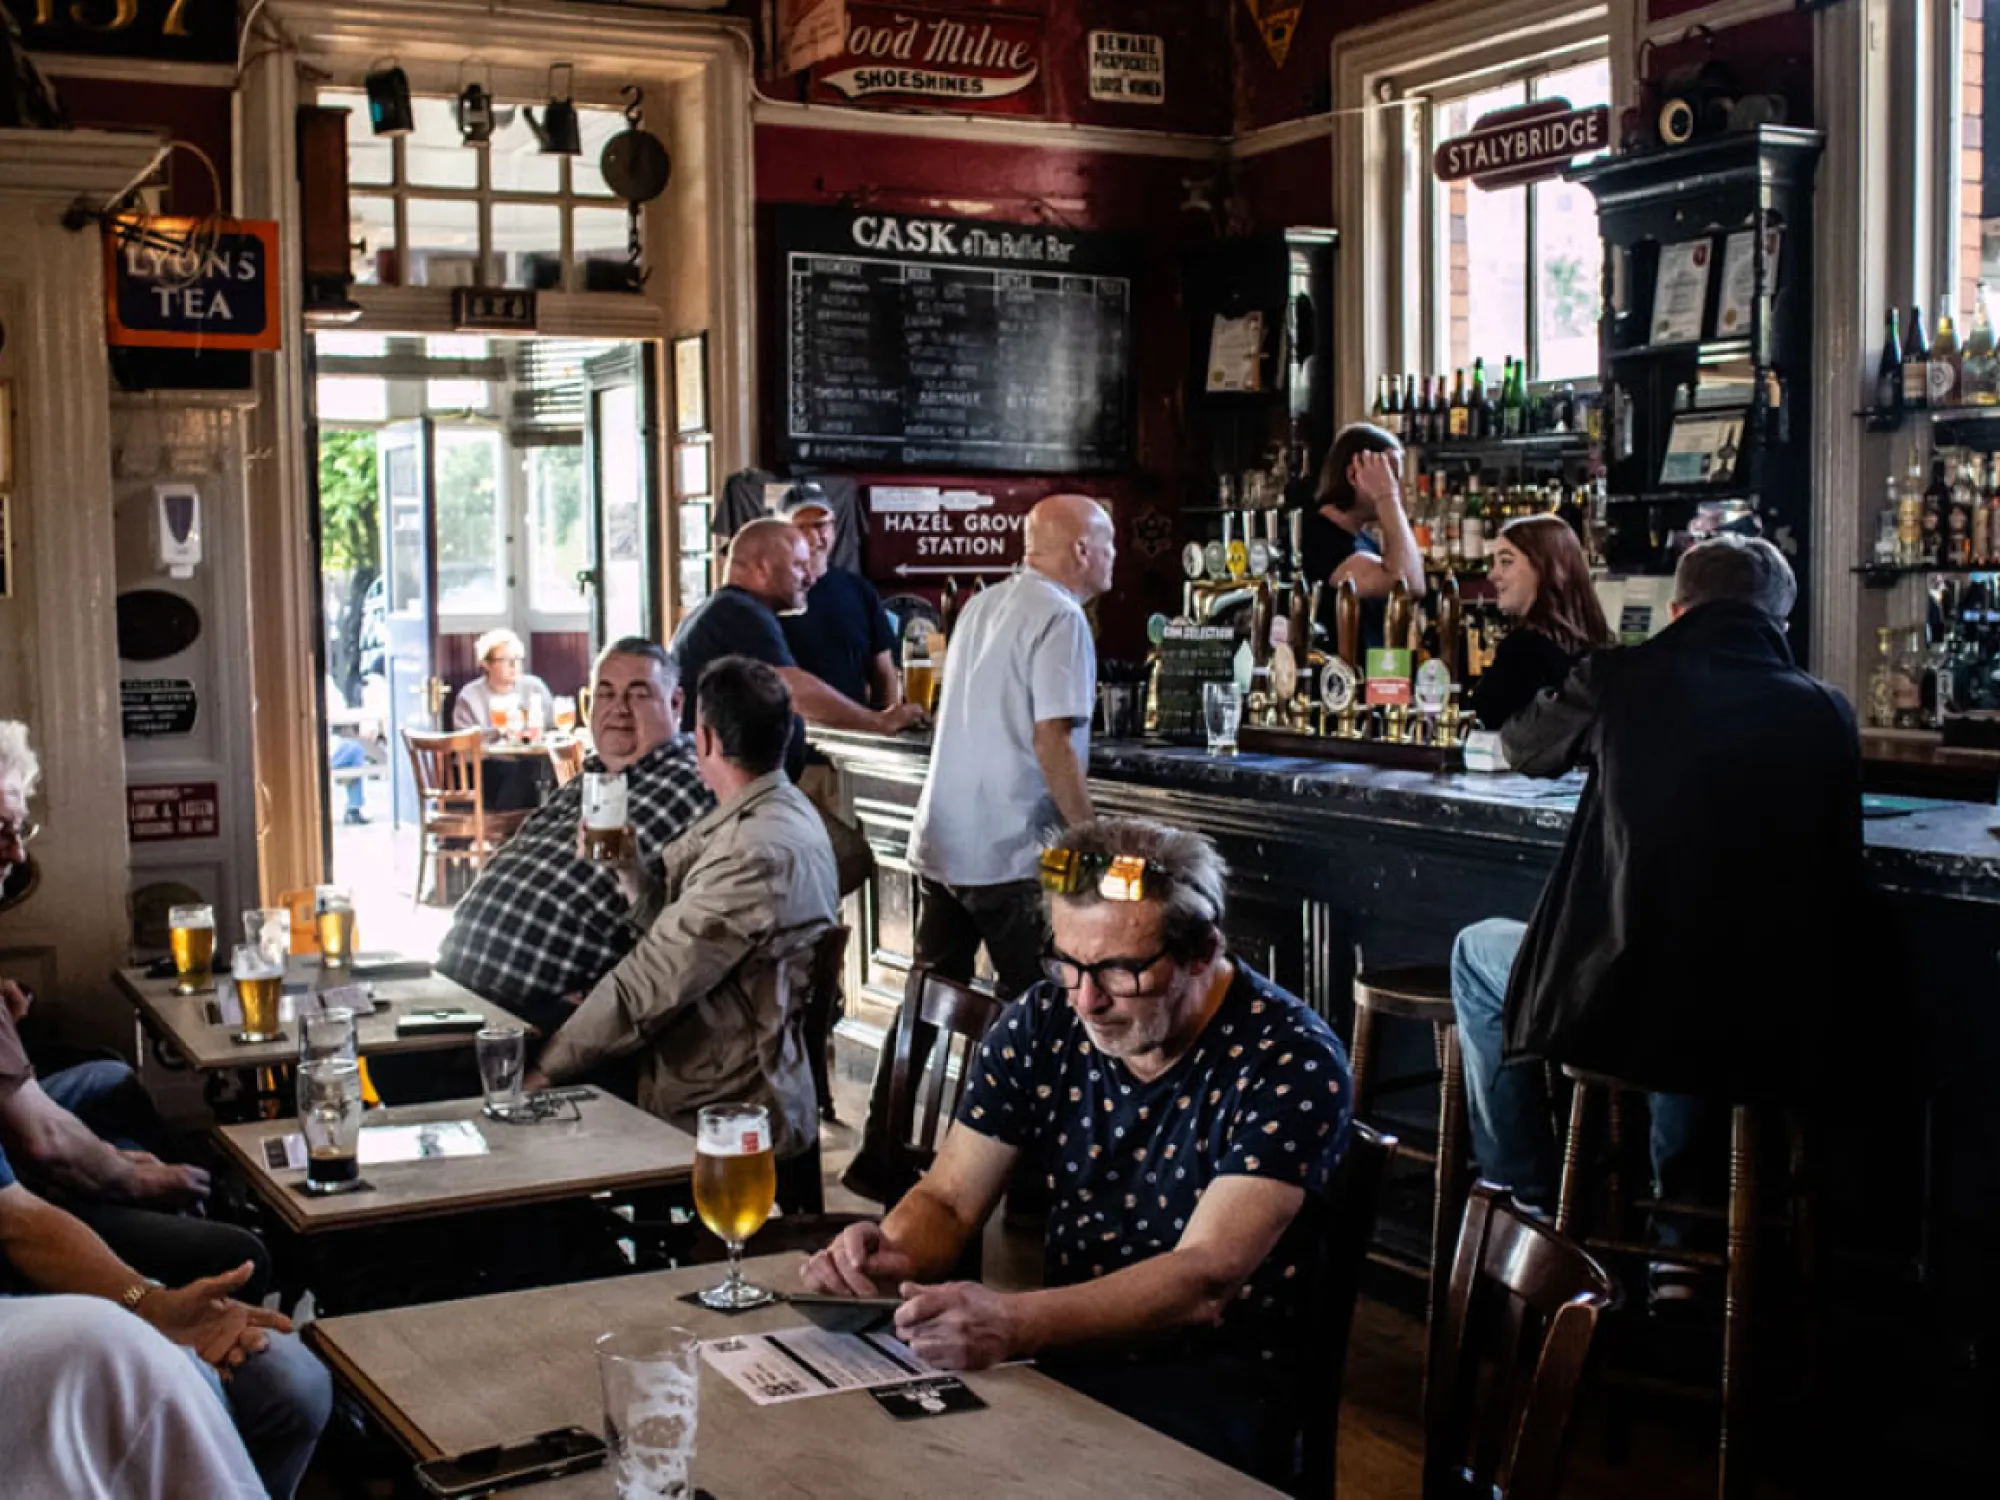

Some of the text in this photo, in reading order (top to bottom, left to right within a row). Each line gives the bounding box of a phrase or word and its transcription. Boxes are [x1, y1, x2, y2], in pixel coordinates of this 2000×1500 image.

[846, 14, 918, 60] ood
[923, 17, 1032, 69] Milne
[853, 69, 984, 94] SHOESHINES
[1449, 110, 1598, 174] STALYBRIDGE
[851, 216, 959, 254] CASK
[1046, 235, 1075, 262] Bar
[126, 247, 256, 281] LYONS
[151, 286, 234, 321] TEA
[884, 513, 1028, 533] HAZEL GROV
[917, 536, 1006, 555] STATION
